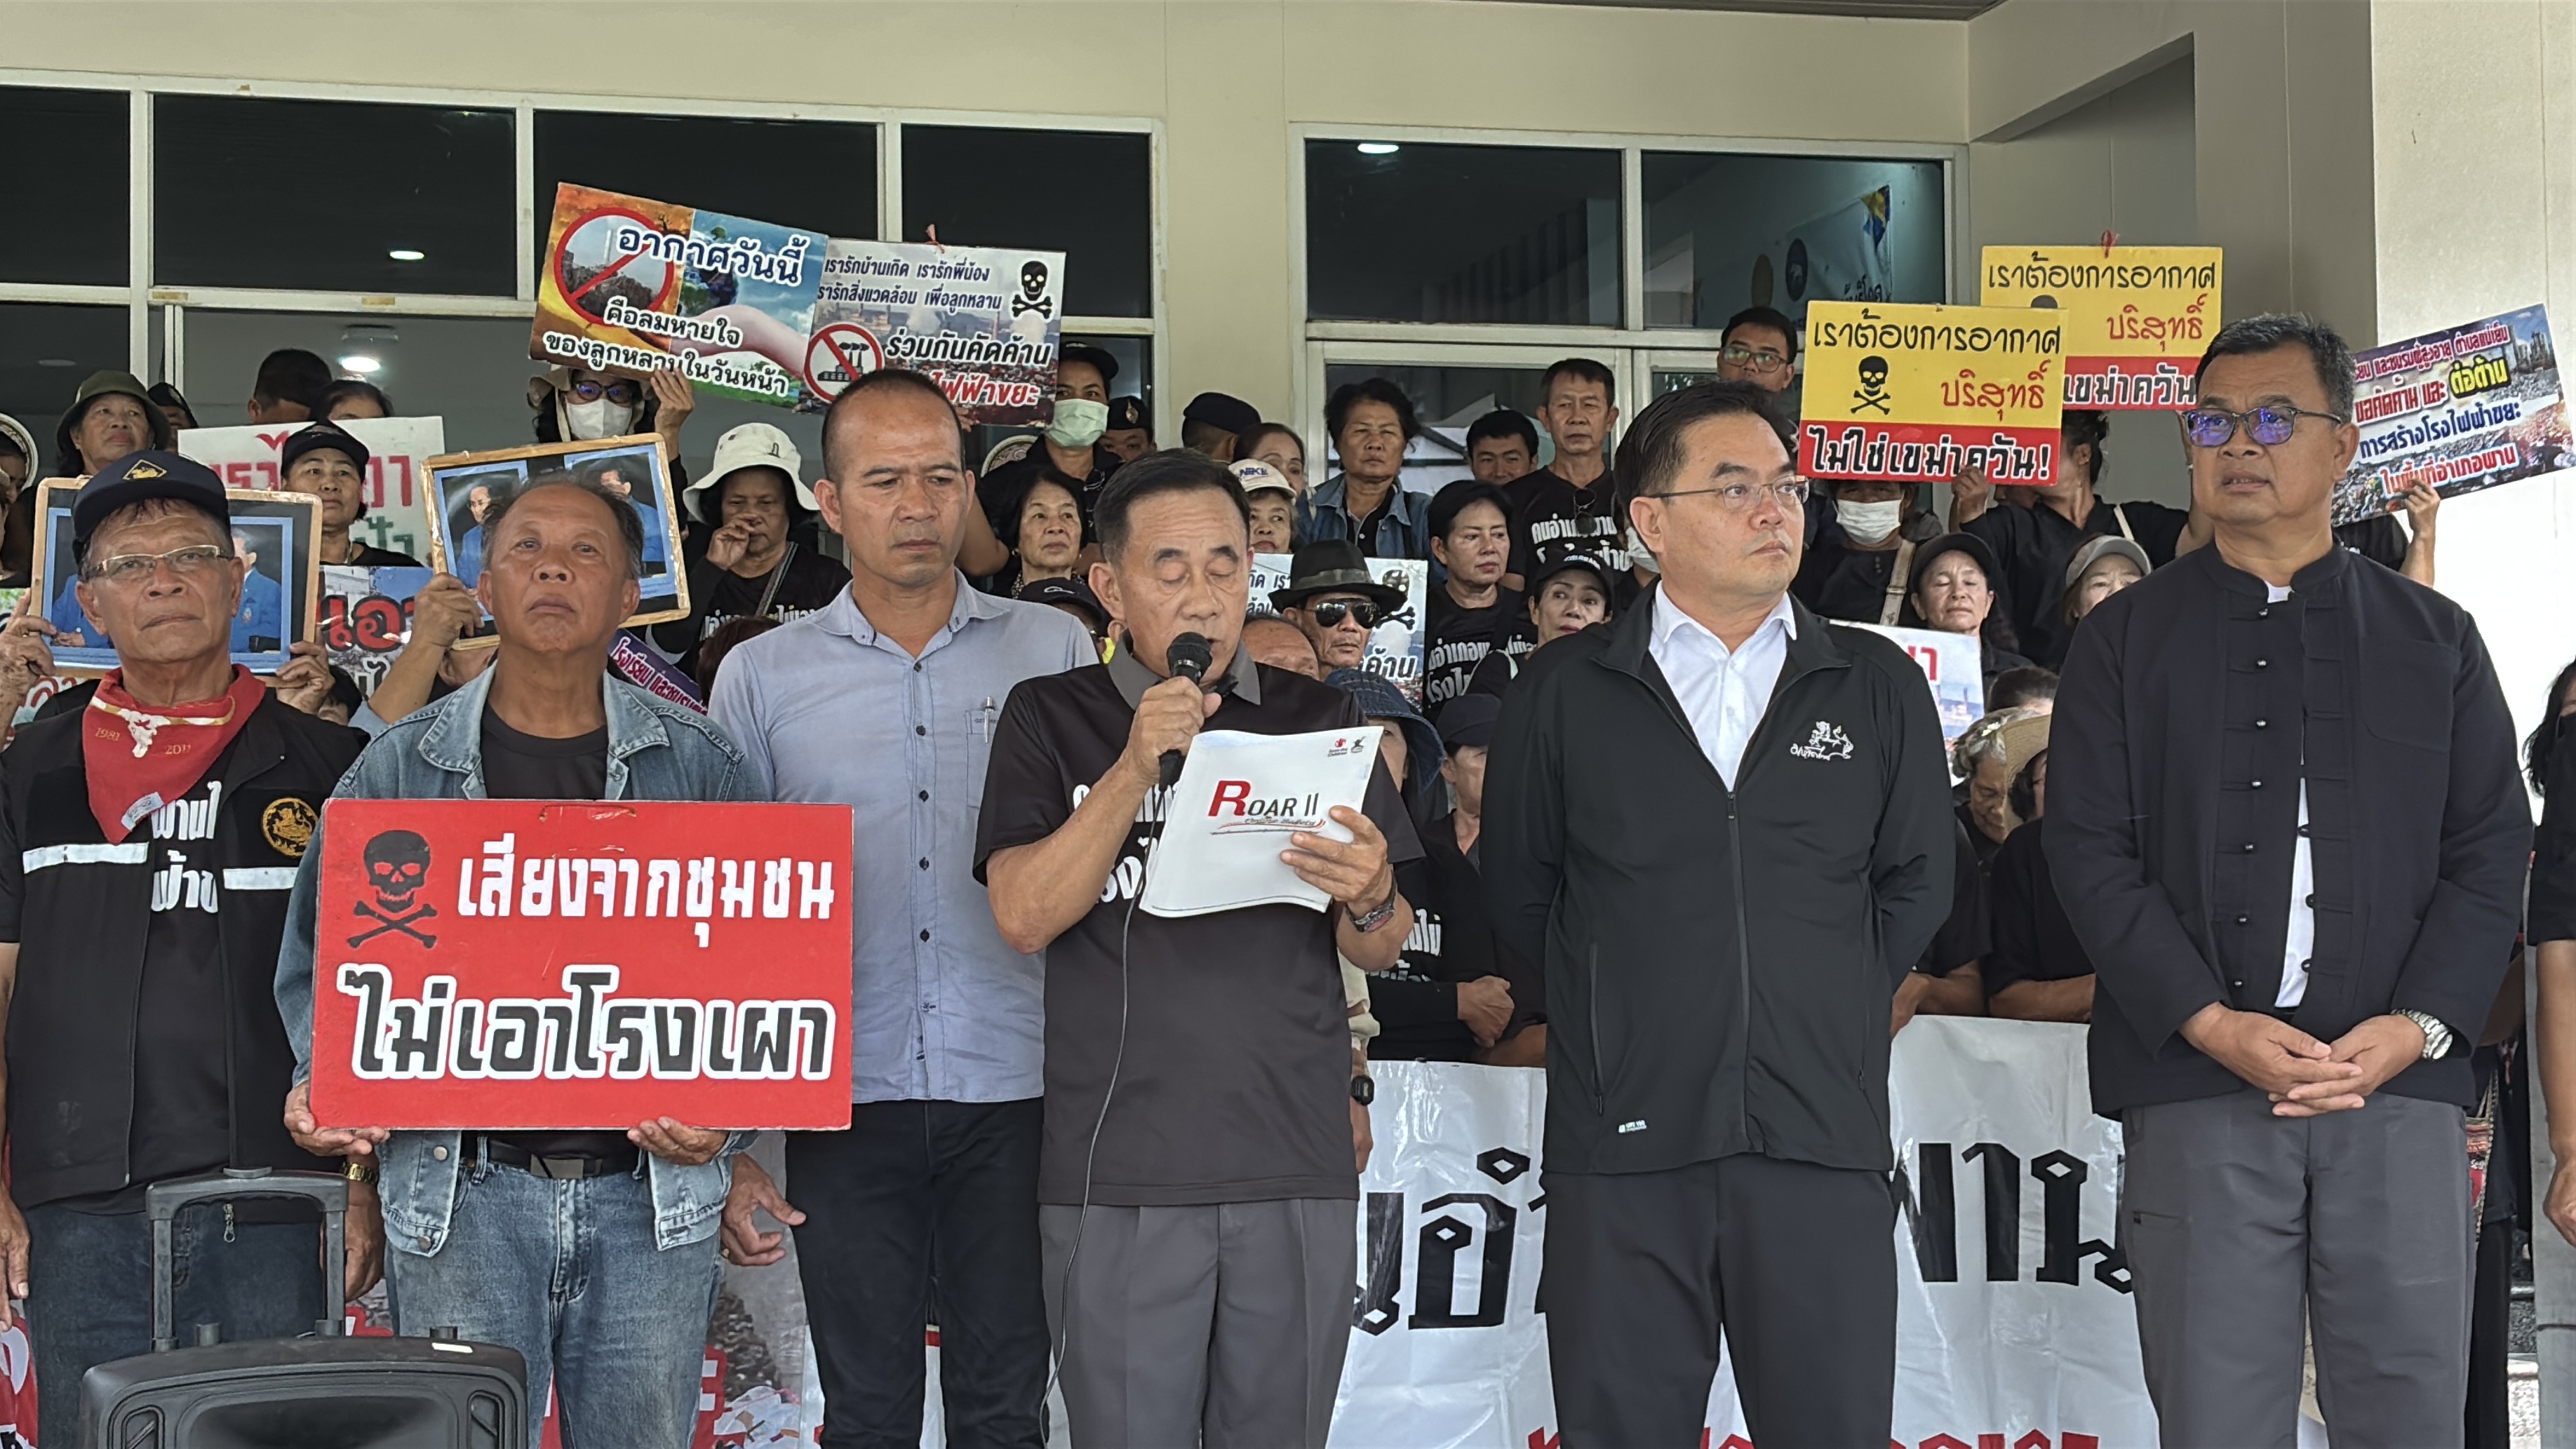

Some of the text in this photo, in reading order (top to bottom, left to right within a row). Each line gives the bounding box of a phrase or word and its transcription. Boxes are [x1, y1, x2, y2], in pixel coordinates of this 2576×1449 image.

[619, 227, 809, 285] อากาศวันนี้
[824, 255, 990, 282] เรารักบ้านเกิด เรารักพี่น้อง
[1988, 251, 2215, 290] เราต้องการอากาศ
[817, 281, 1002, 309] รารักสิ่งแวดล้อม เพื่อลูกหลาน
[605, 298, 742, 346] คือลมหายใจ
[886, 327, 1052, 366] ร่วมกันคัดค้าน
[1813, 308, 2062, 354] เราต้องการอากาศ
[2107, 293, 2208, 353] บริสุทธิ์
[545, 332, 787, 396] ของลูกหลานในวันหน้า
[2422, 380, 2447, 406] และ
[2450, 358, 2509, 395] ต่อต้าน
[1940, 358, 2052, 422] บริสุทธิ์
[1806, 425, 2052, 480] ไม่ใช่เขม่าควัน!
[2359, 401, 2521, 459] การสร้างโรงไฟฟ้าขยะ
[1207, 780, 1298, 817] ROAR
[458, 833, 835, 948] เสียงจากชุมชน
[340, 966, 833, 1078] ไม่เอาโรงเผา
